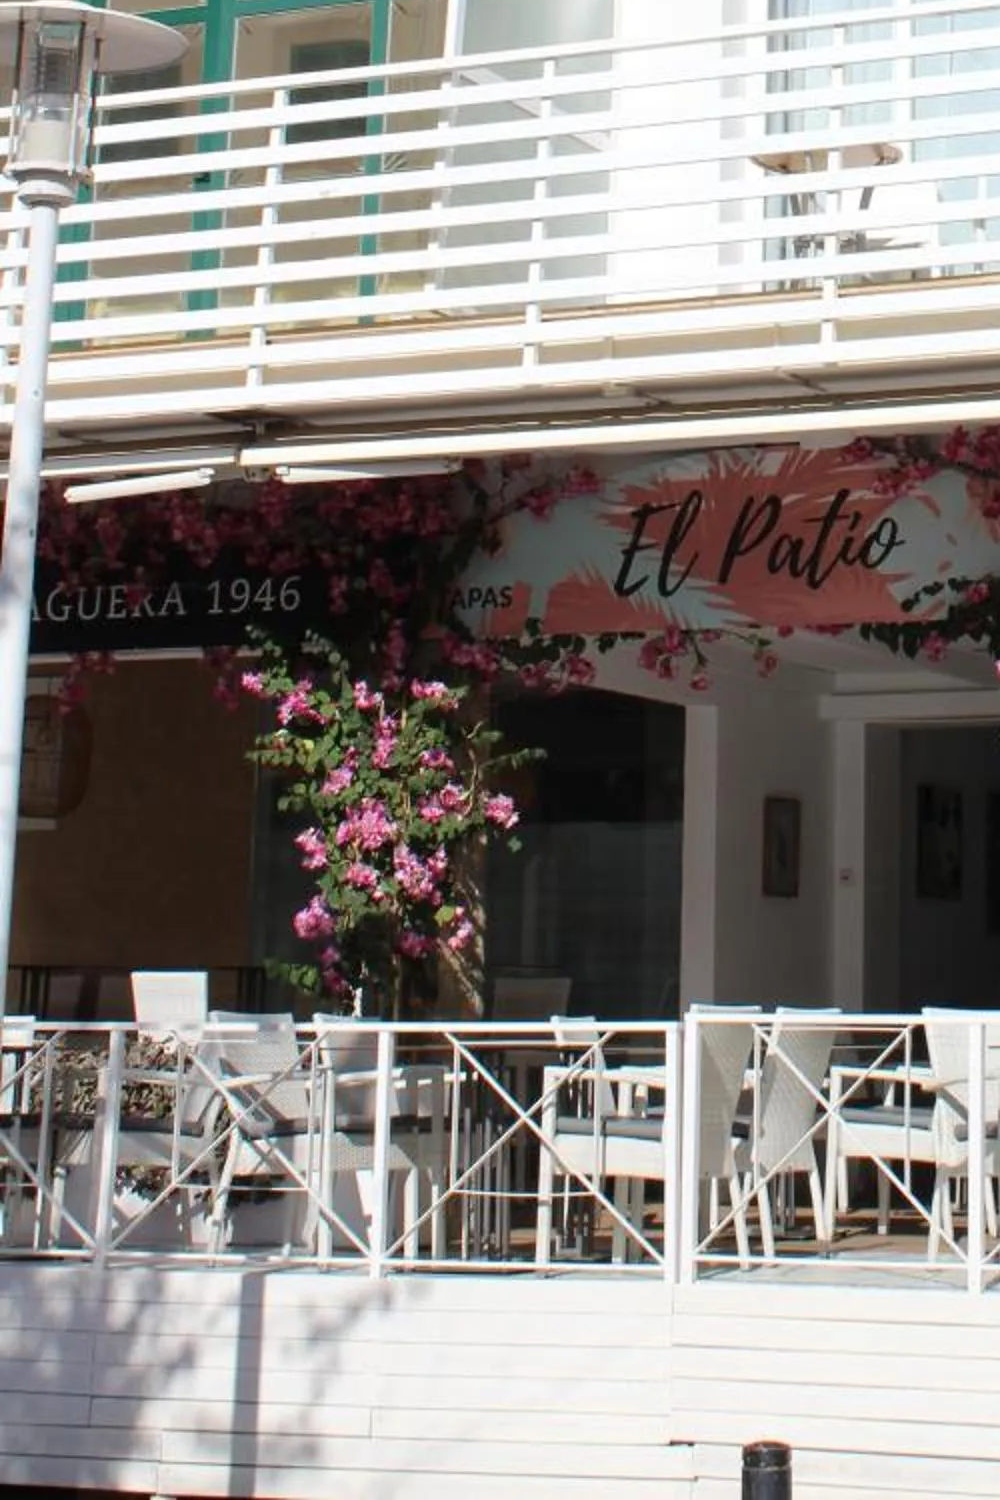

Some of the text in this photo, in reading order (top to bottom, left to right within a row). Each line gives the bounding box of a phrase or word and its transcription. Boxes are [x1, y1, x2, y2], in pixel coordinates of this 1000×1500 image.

[614, 488, 904, 597] El Patio
[207, 576, 301, 614] 1946
